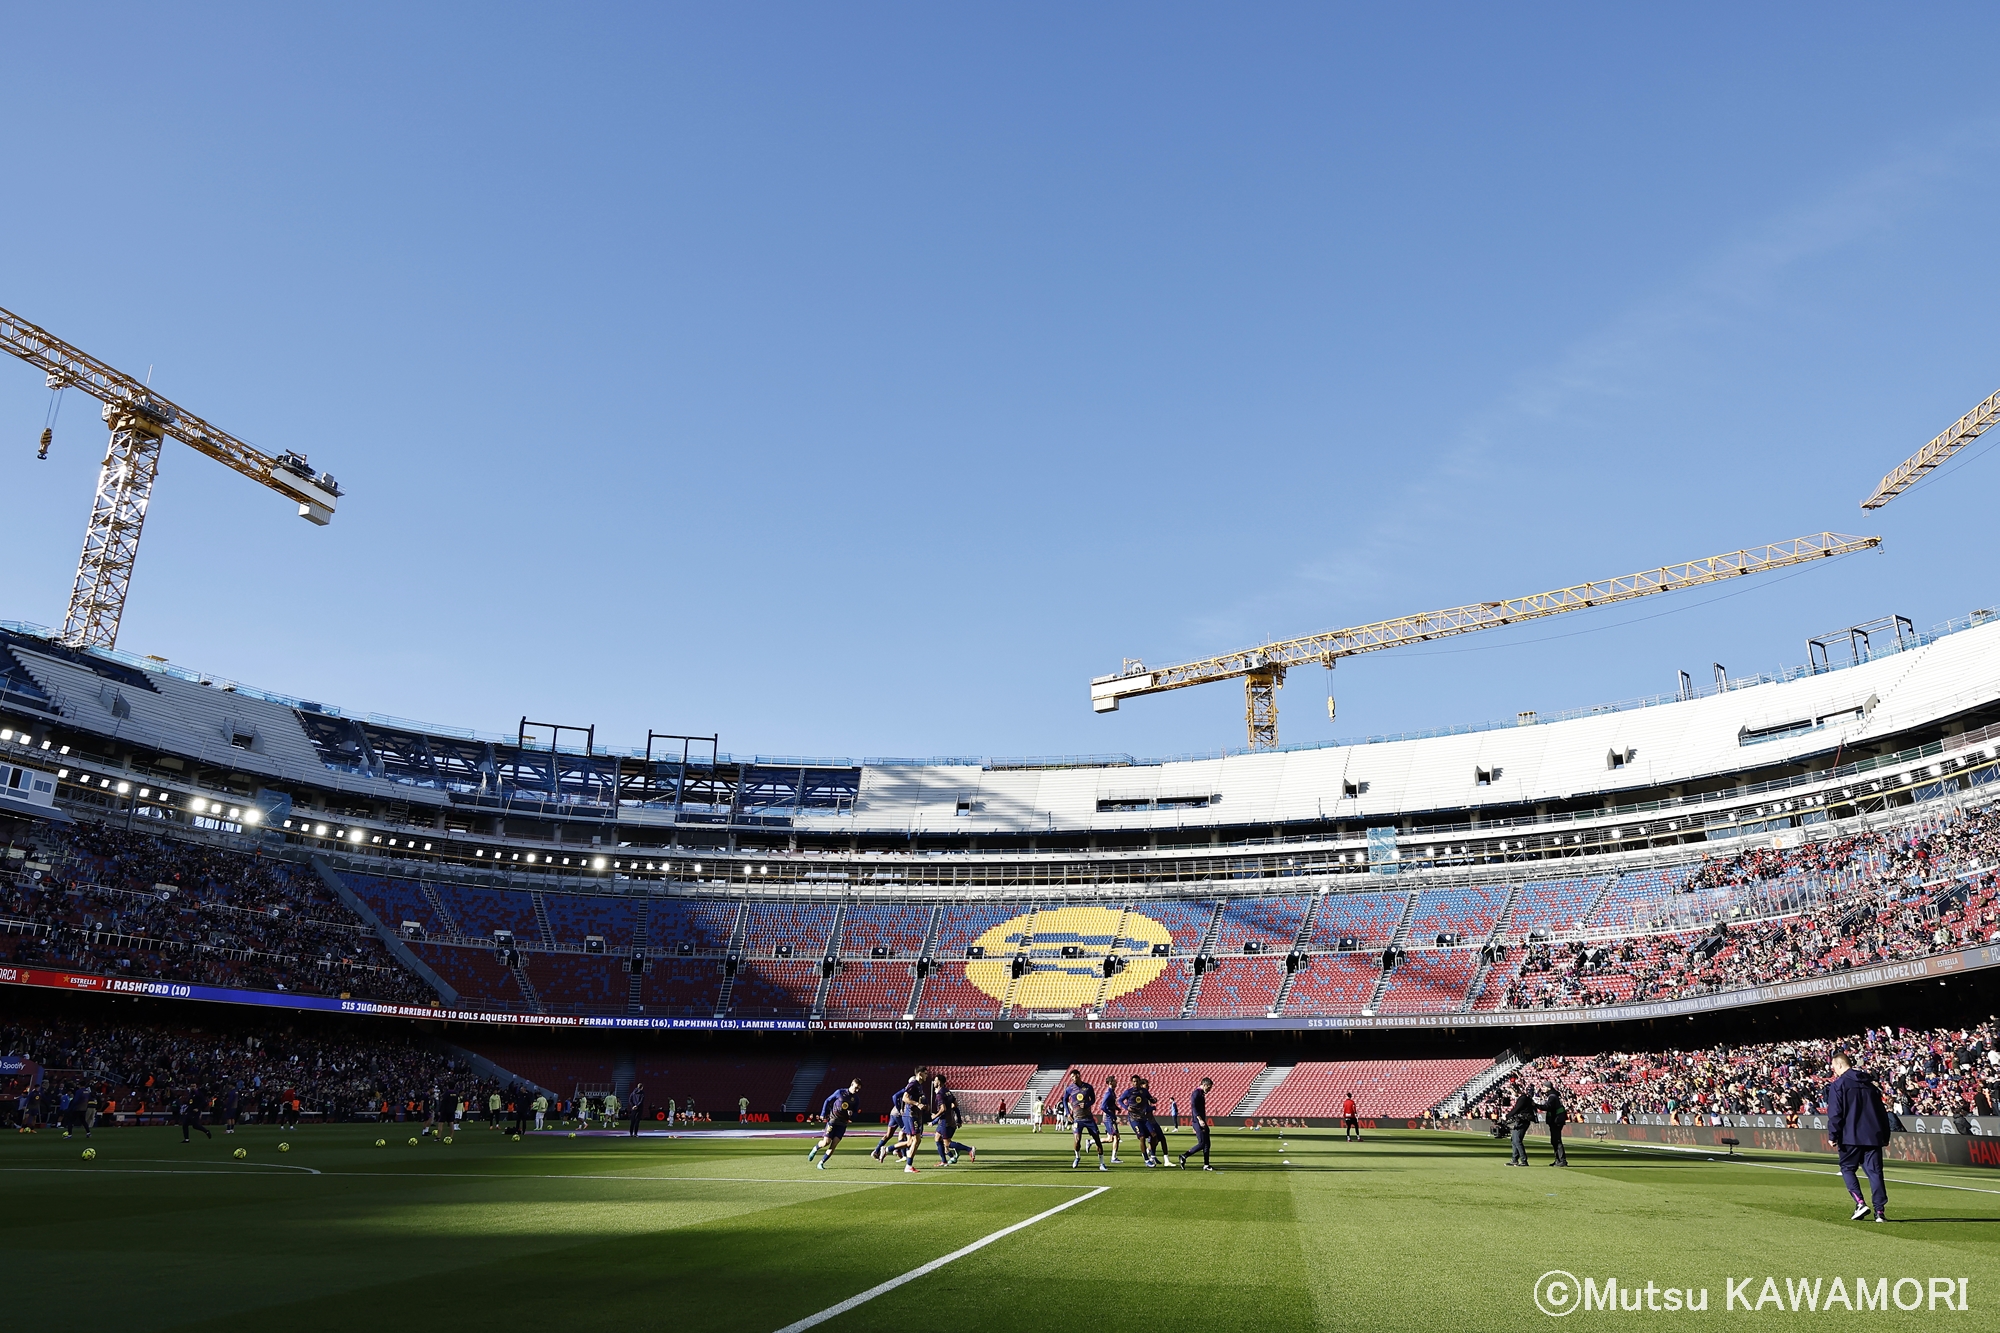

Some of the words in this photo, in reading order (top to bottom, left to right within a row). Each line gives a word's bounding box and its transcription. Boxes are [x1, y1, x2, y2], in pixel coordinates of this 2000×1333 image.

[1937, 957, 1958, 968] ESTRELLA
[70, 977, 97, 985] ESTRELLA
[114, 981, 169, 994] RASHFORD
[171, 985, 190, 997] (10)
[1308, 1019, 1323, 1027] SIS
[1325, 1018, 1373, 1027] JUGADORS
[1376, 1017, 1417, 1026] ARRIBEN
[1420, 1017, 1436, 1025] ALS
[1439, 1016, 1450, 1024] 10
[1452, 1016, 1476, 1024] GOLS
[1478, 1015, 1522, 1025] AQUESTA
[1524, 1012, 1584, 1022] TEMPORADA:
[1586, 1010, 1618, 1020] FERRAN
[1621, 1007, 1649, 1017] TORRES
[1652, 1005, 1667, 1016] (16),
[1668, 1003, 1699, 1013] RAPHINHA
[1713, 996, 1738, 1006] LAMINE
[1738, 991, 1761, 1002] YAMAL
[1777, 979, 1832, 997] LEWANDOWSKI
[1833, 975, 1850, 989] (12),
[1851, 968, 1882, 986] FERMÍN
[1884, 964, 1910, 980] LÓPEZ
[1910, 960, 1928, 976] (10)
[342, 1002, 355, 1010] SIS
[356, 1003, 397, 1014] JUGADORS
[398, 1006, 431, 1017] ARRIBEN
[432, 1010, 446, 1018] ALS
[448, 1011, 456, 1019] 10
[458, 1012, 478, 1021] GOLS
[480, 1013, 518, 1023] AQUESTA
[520, 1015, 577, 1025] TEMPORADA:
[579, 1018, 613, 1026] FERRAN
[616, 1018, 649, 1027] TORRES
[651, 1018, 671, 1028] (16),
[673, 1020, 718, 1028] RAPHINHA
[720, 1020, 739, 1029] (13),
[741, 1020, 774, 1028] LAMINE
[776, 1021, 806, 1029] YAMAL
[808, 1020, 826, 1030] (13),
[828, 1021, 893, 1029] LEWANDOWSKI
[894, 1021, 913, 1030] (12),
[915, 1020, 948, 1030] FERMÍN
[950, 1020, 976, 1030] LÓPEZ
[978, 1021, 993, 1030] (10)
[1142, 1021, 1158, 1030] (10)
[2, 1061, 26, 1070] Spotify
